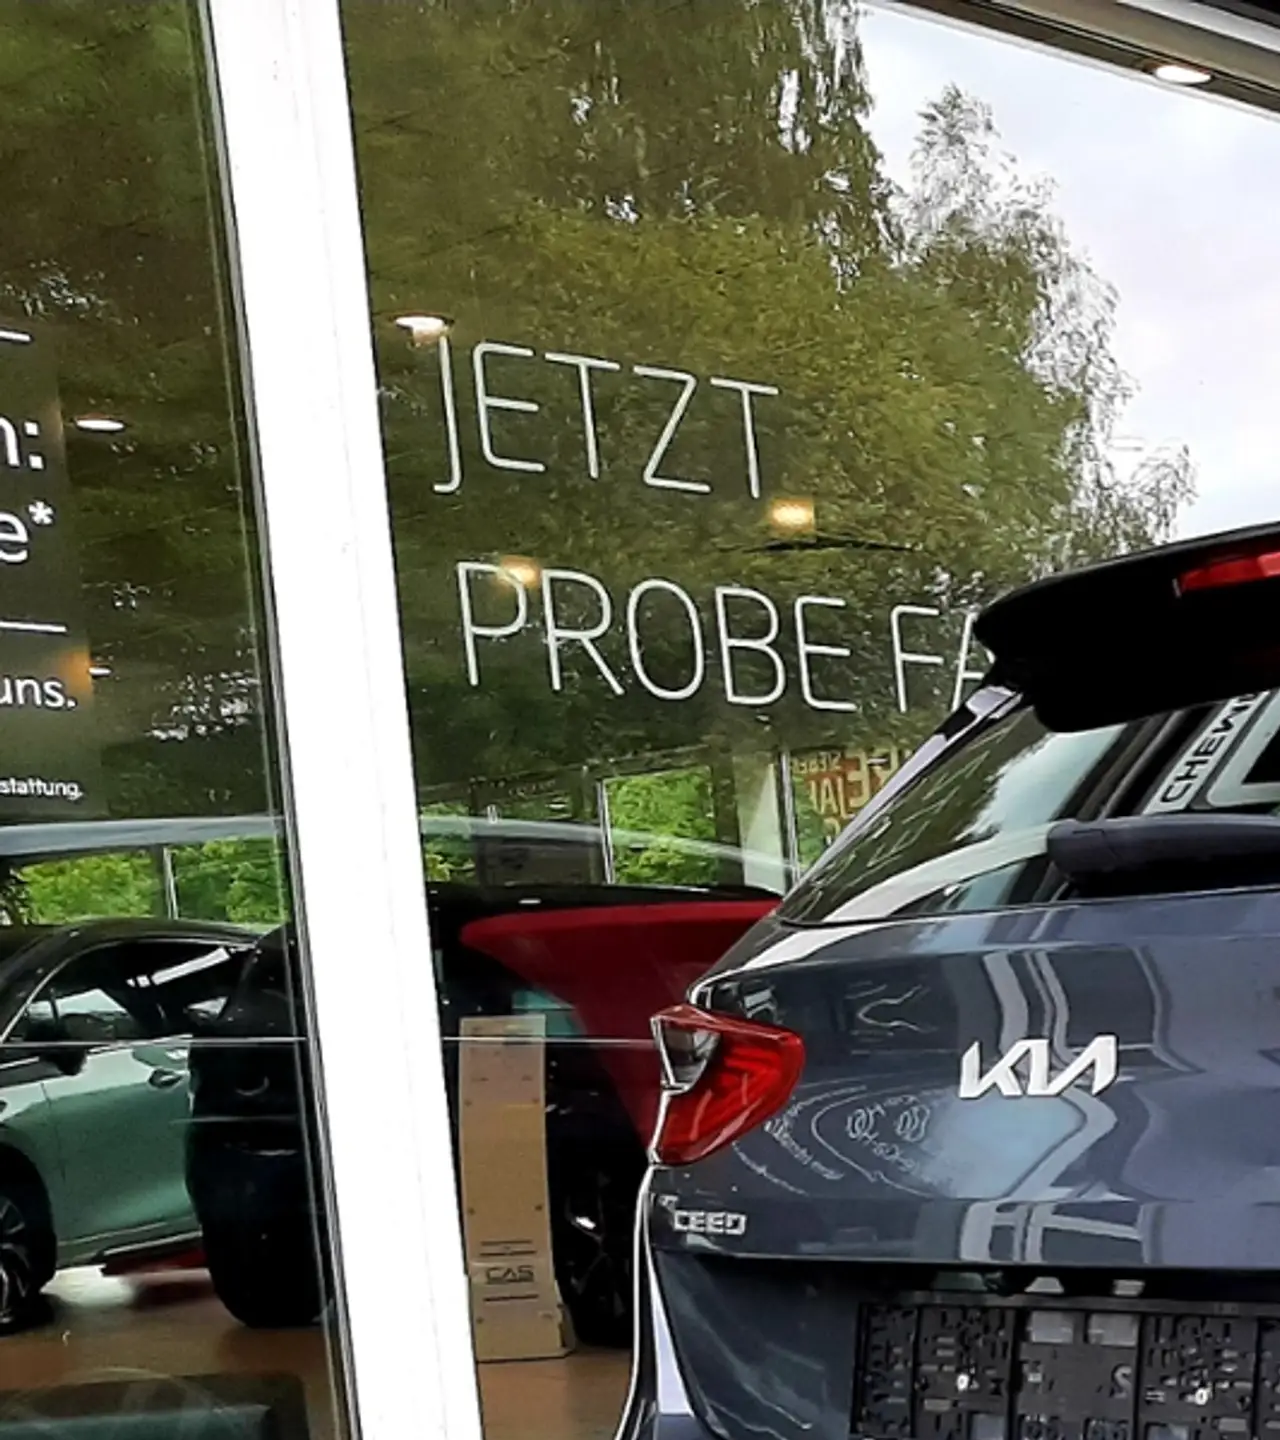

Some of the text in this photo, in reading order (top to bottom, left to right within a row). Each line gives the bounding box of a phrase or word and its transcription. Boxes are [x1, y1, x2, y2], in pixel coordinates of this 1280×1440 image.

[433, 335, 780, 500] JETZT
[457, 561, 858, 713] PROBE
[958, 1034, 1118, 1099] KIA
[674, 1210, 747, 1235] CEED
